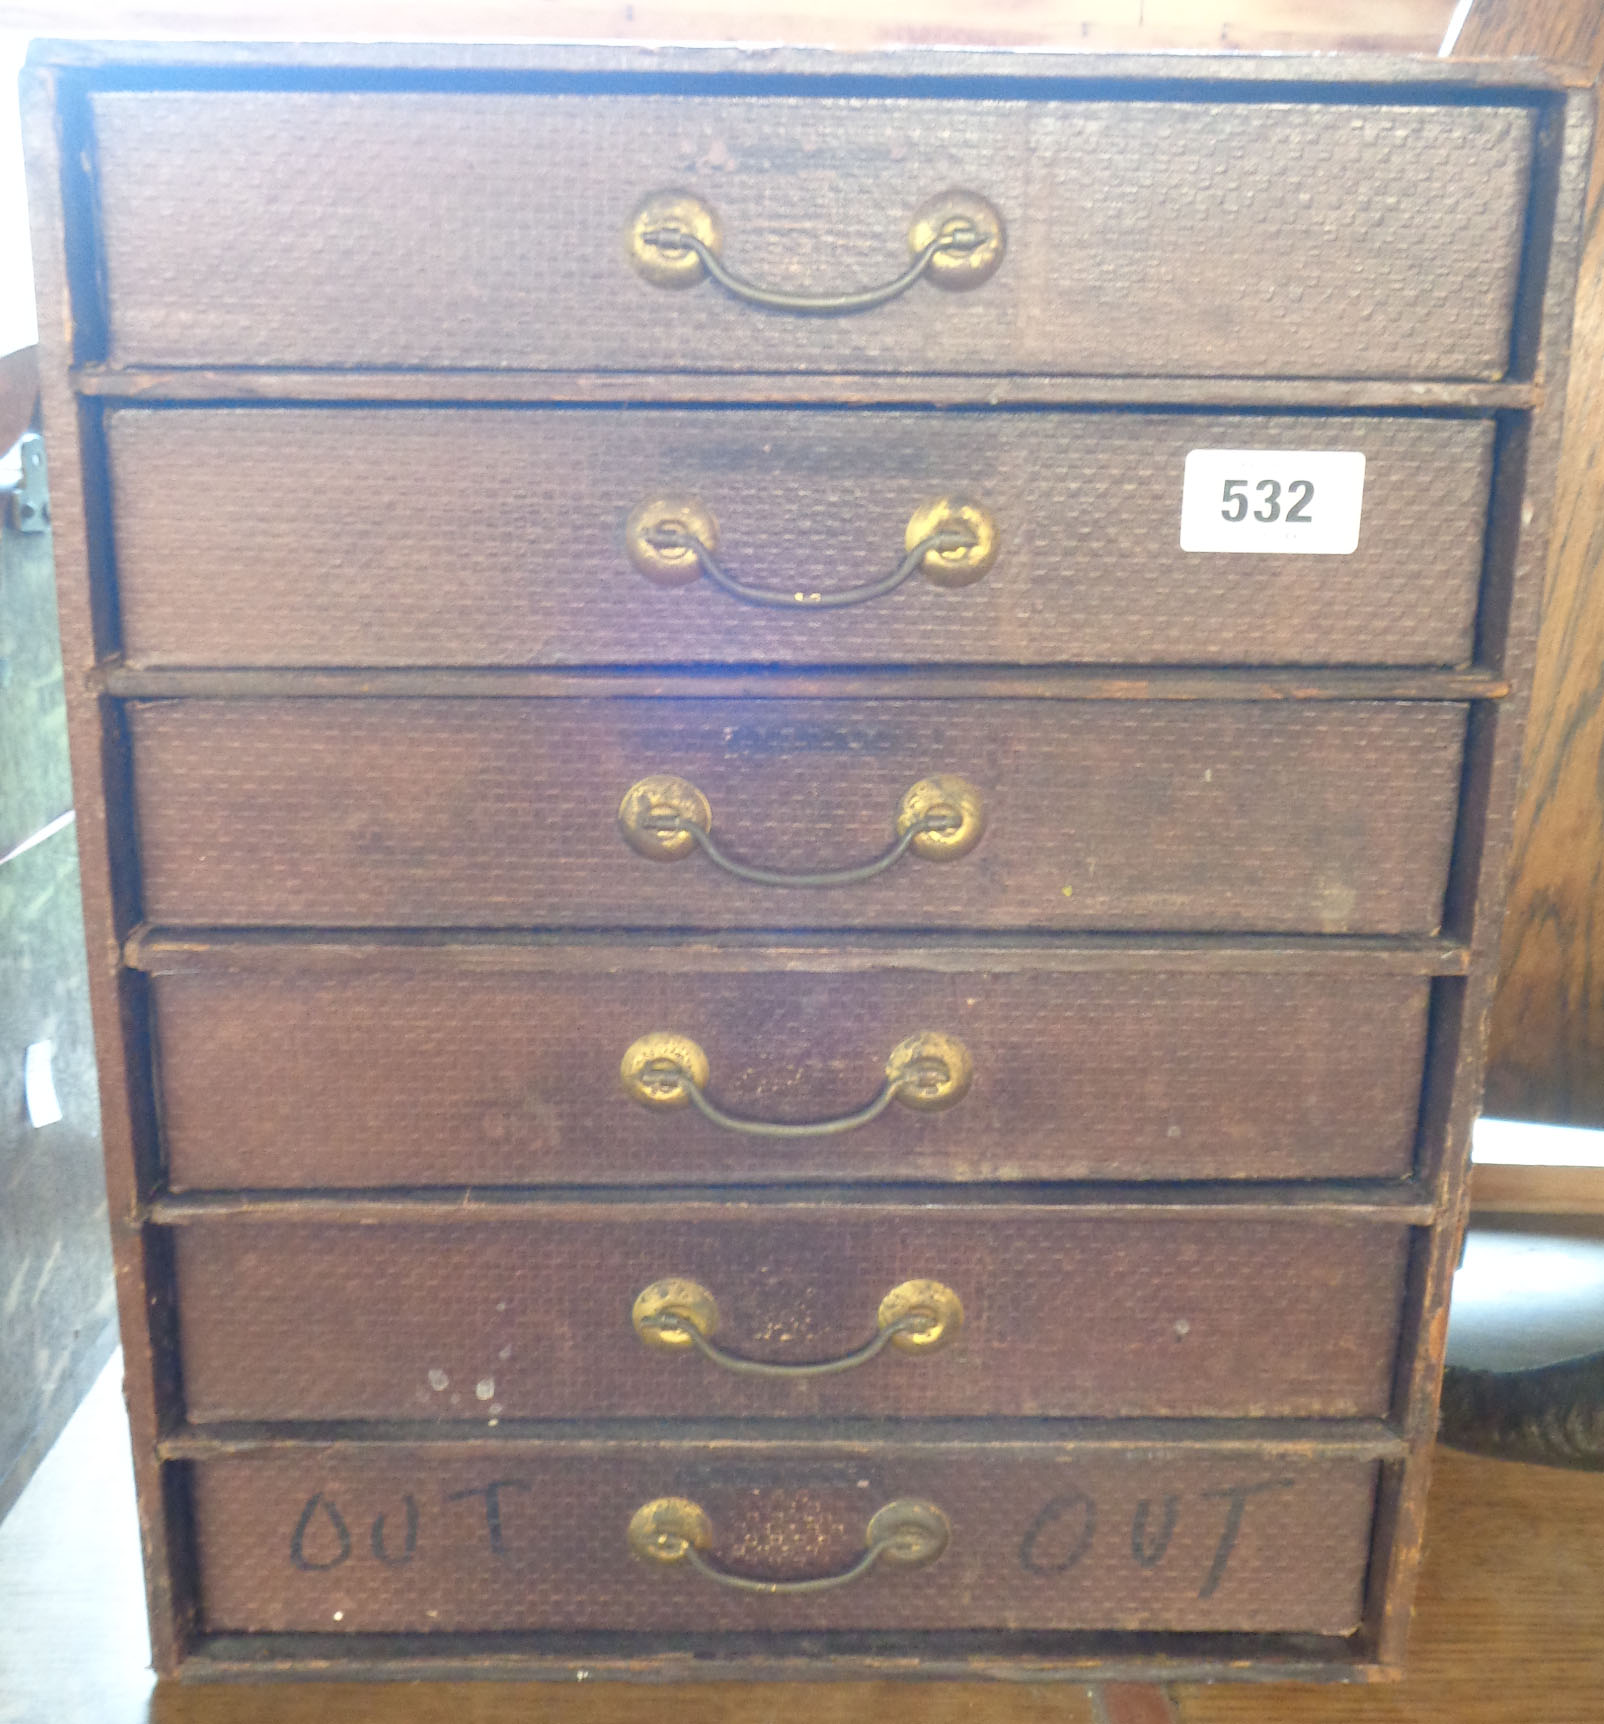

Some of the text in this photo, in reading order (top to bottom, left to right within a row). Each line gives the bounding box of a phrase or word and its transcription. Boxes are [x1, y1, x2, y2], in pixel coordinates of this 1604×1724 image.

[1221, 479, 1315, 523] 532
[290, 1479, 532, 1571] OUT
[1019, 1477, 1295, 1600] OUT
